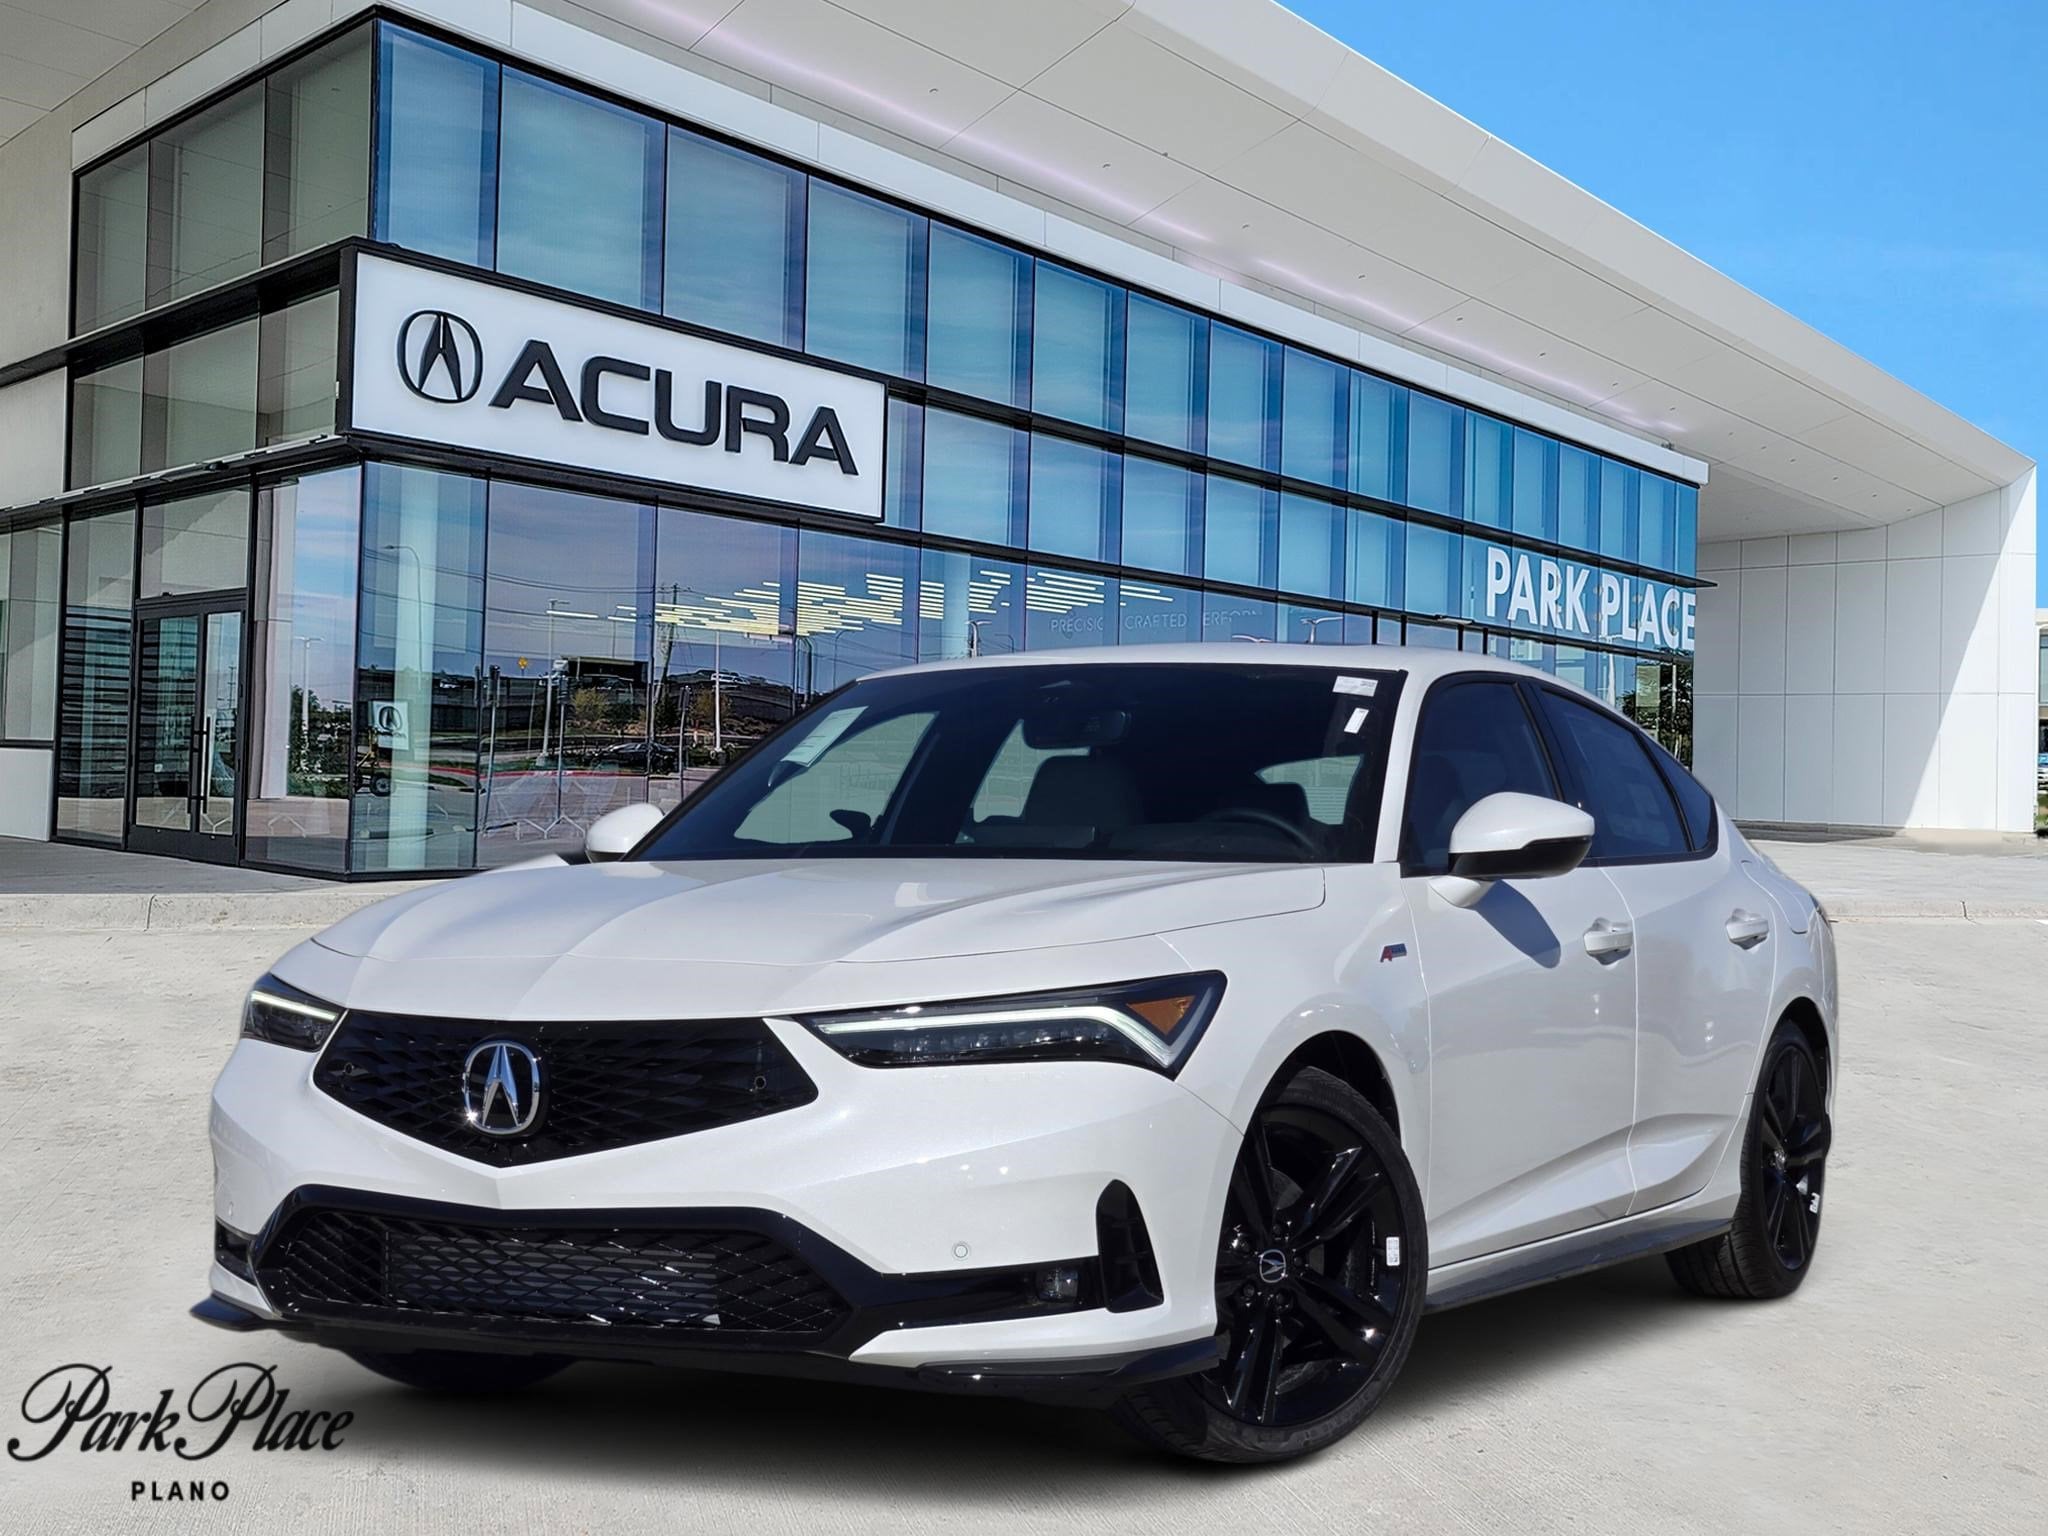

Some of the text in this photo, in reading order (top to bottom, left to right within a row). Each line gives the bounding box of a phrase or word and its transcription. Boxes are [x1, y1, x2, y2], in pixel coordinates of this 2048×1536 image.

[488, 339, 859, 476] ACURA
[1124, 613, 1187, 630] CRAFTED
[1486, 546, 1696, 650] PARK PLACE
